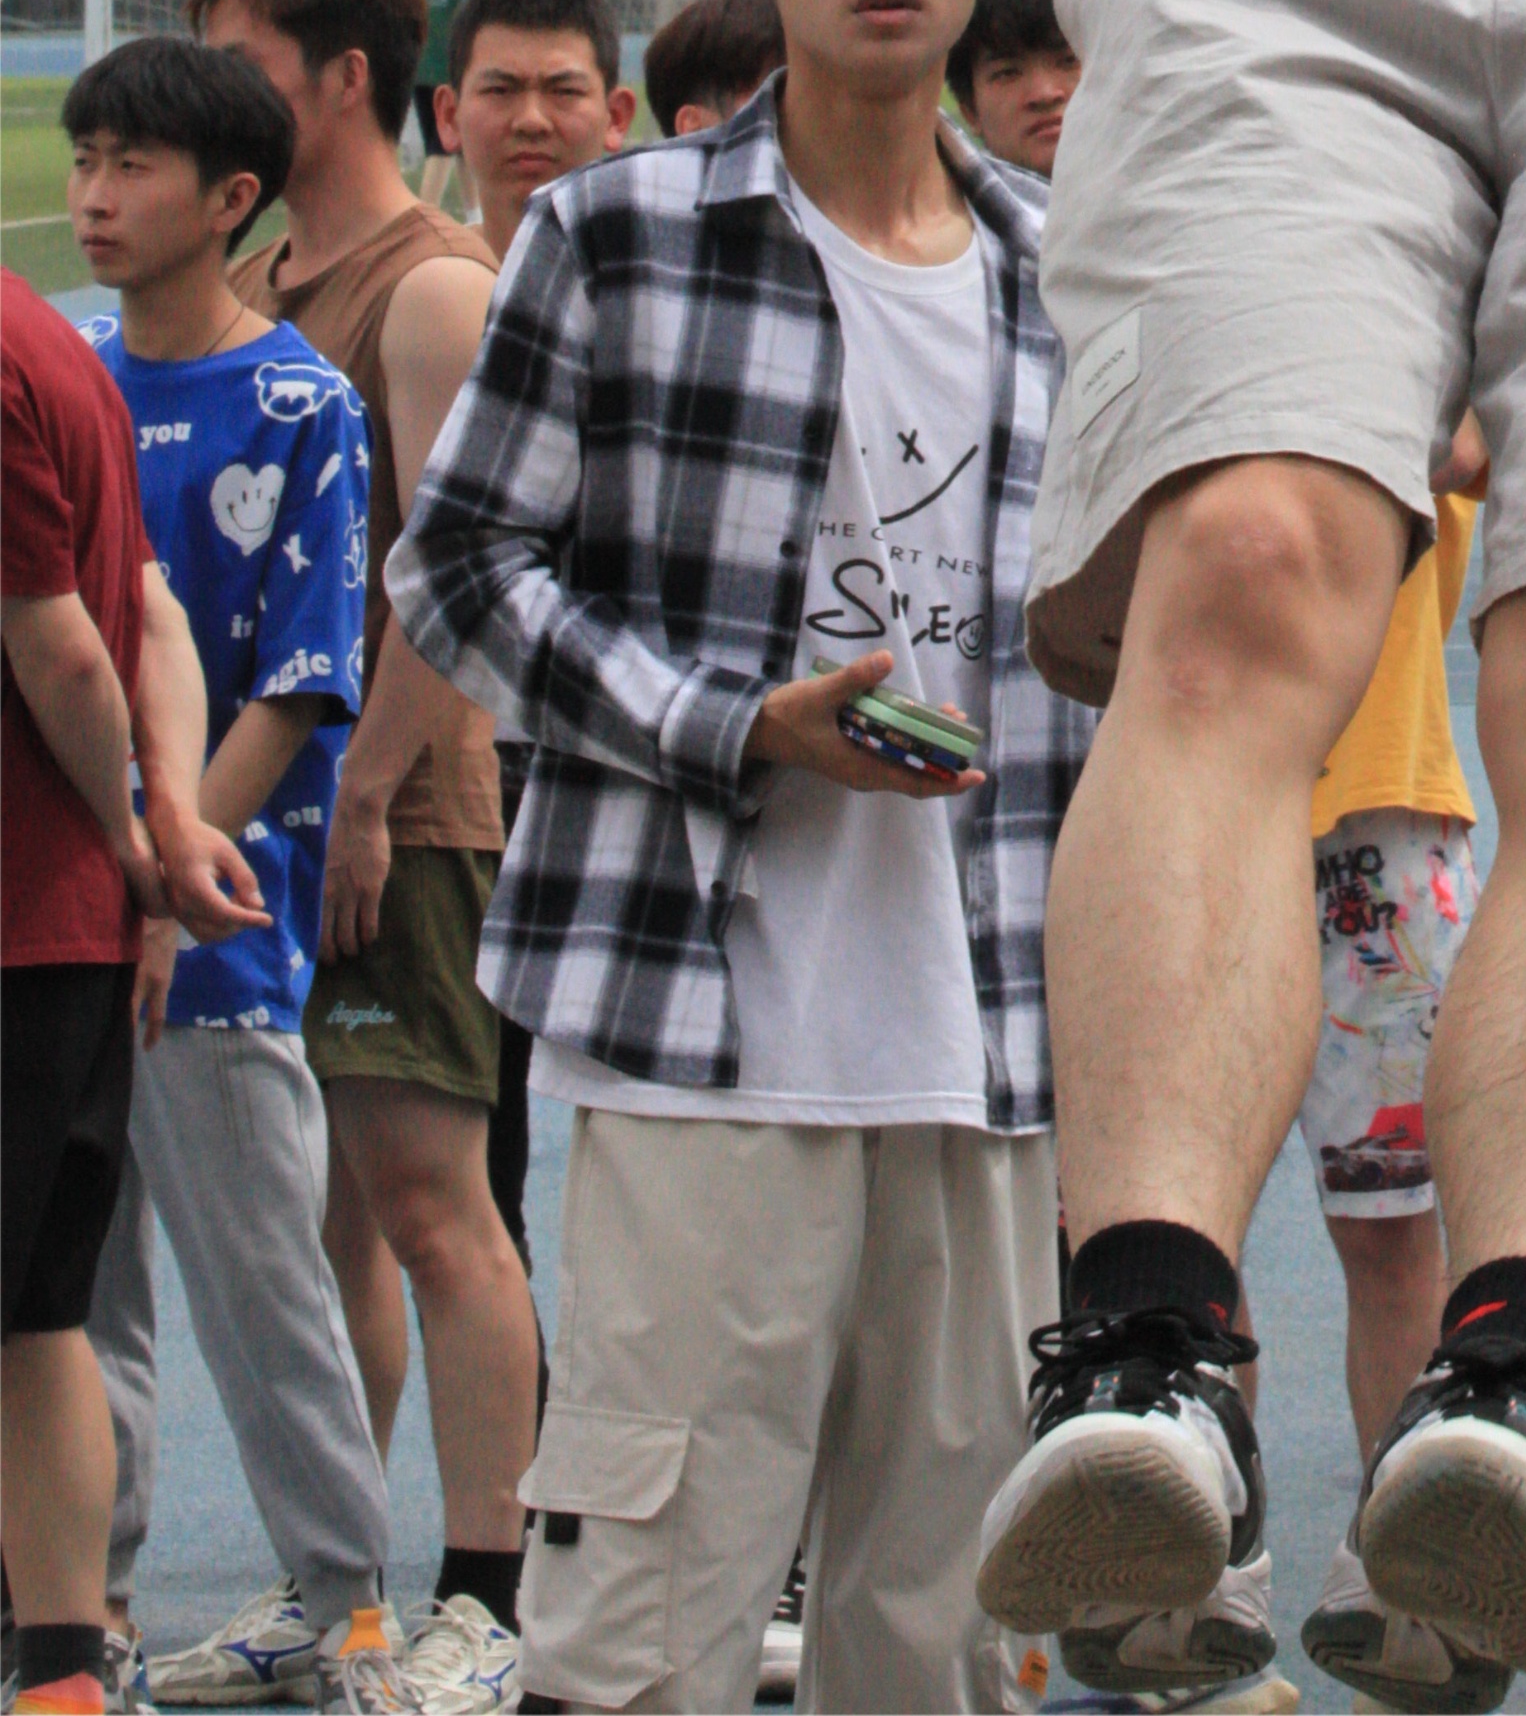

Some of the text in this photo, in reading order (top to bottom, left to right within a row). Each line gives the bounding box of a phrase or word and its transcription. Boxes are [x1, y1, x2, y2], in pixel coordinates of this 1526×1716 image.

[139, 421, 192, 450] you
[818, 521, 857, 538] HE
[282, 805, 323, 828] ou
